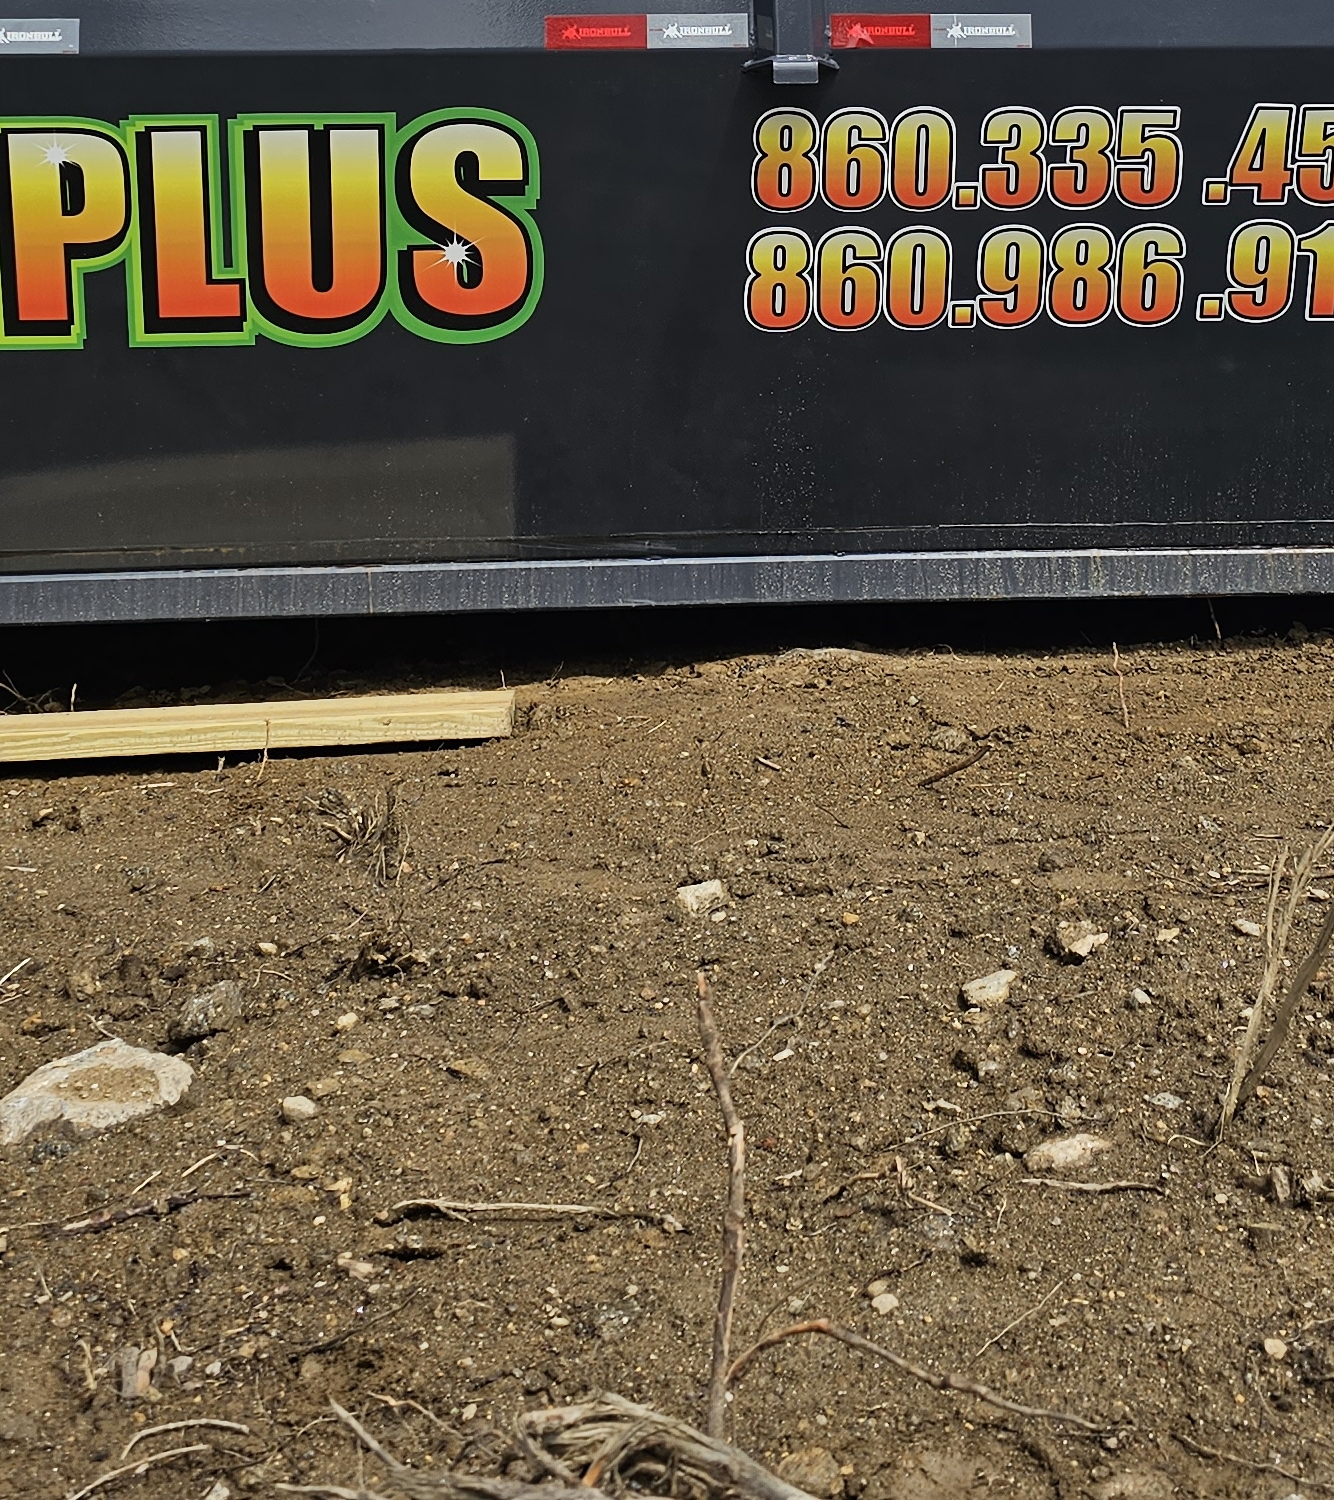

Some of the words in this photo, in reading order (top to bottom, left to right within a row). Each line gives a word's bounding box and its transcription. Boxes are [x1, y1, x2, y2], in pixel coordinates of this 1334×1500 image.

[578, 26, 631, 37] IRONBULL
[679, 25, 733, 36] IRONBULL
[863, 26, 916, 37] IRONBULL
[963, 25, 1016, 36] IRONBULL
